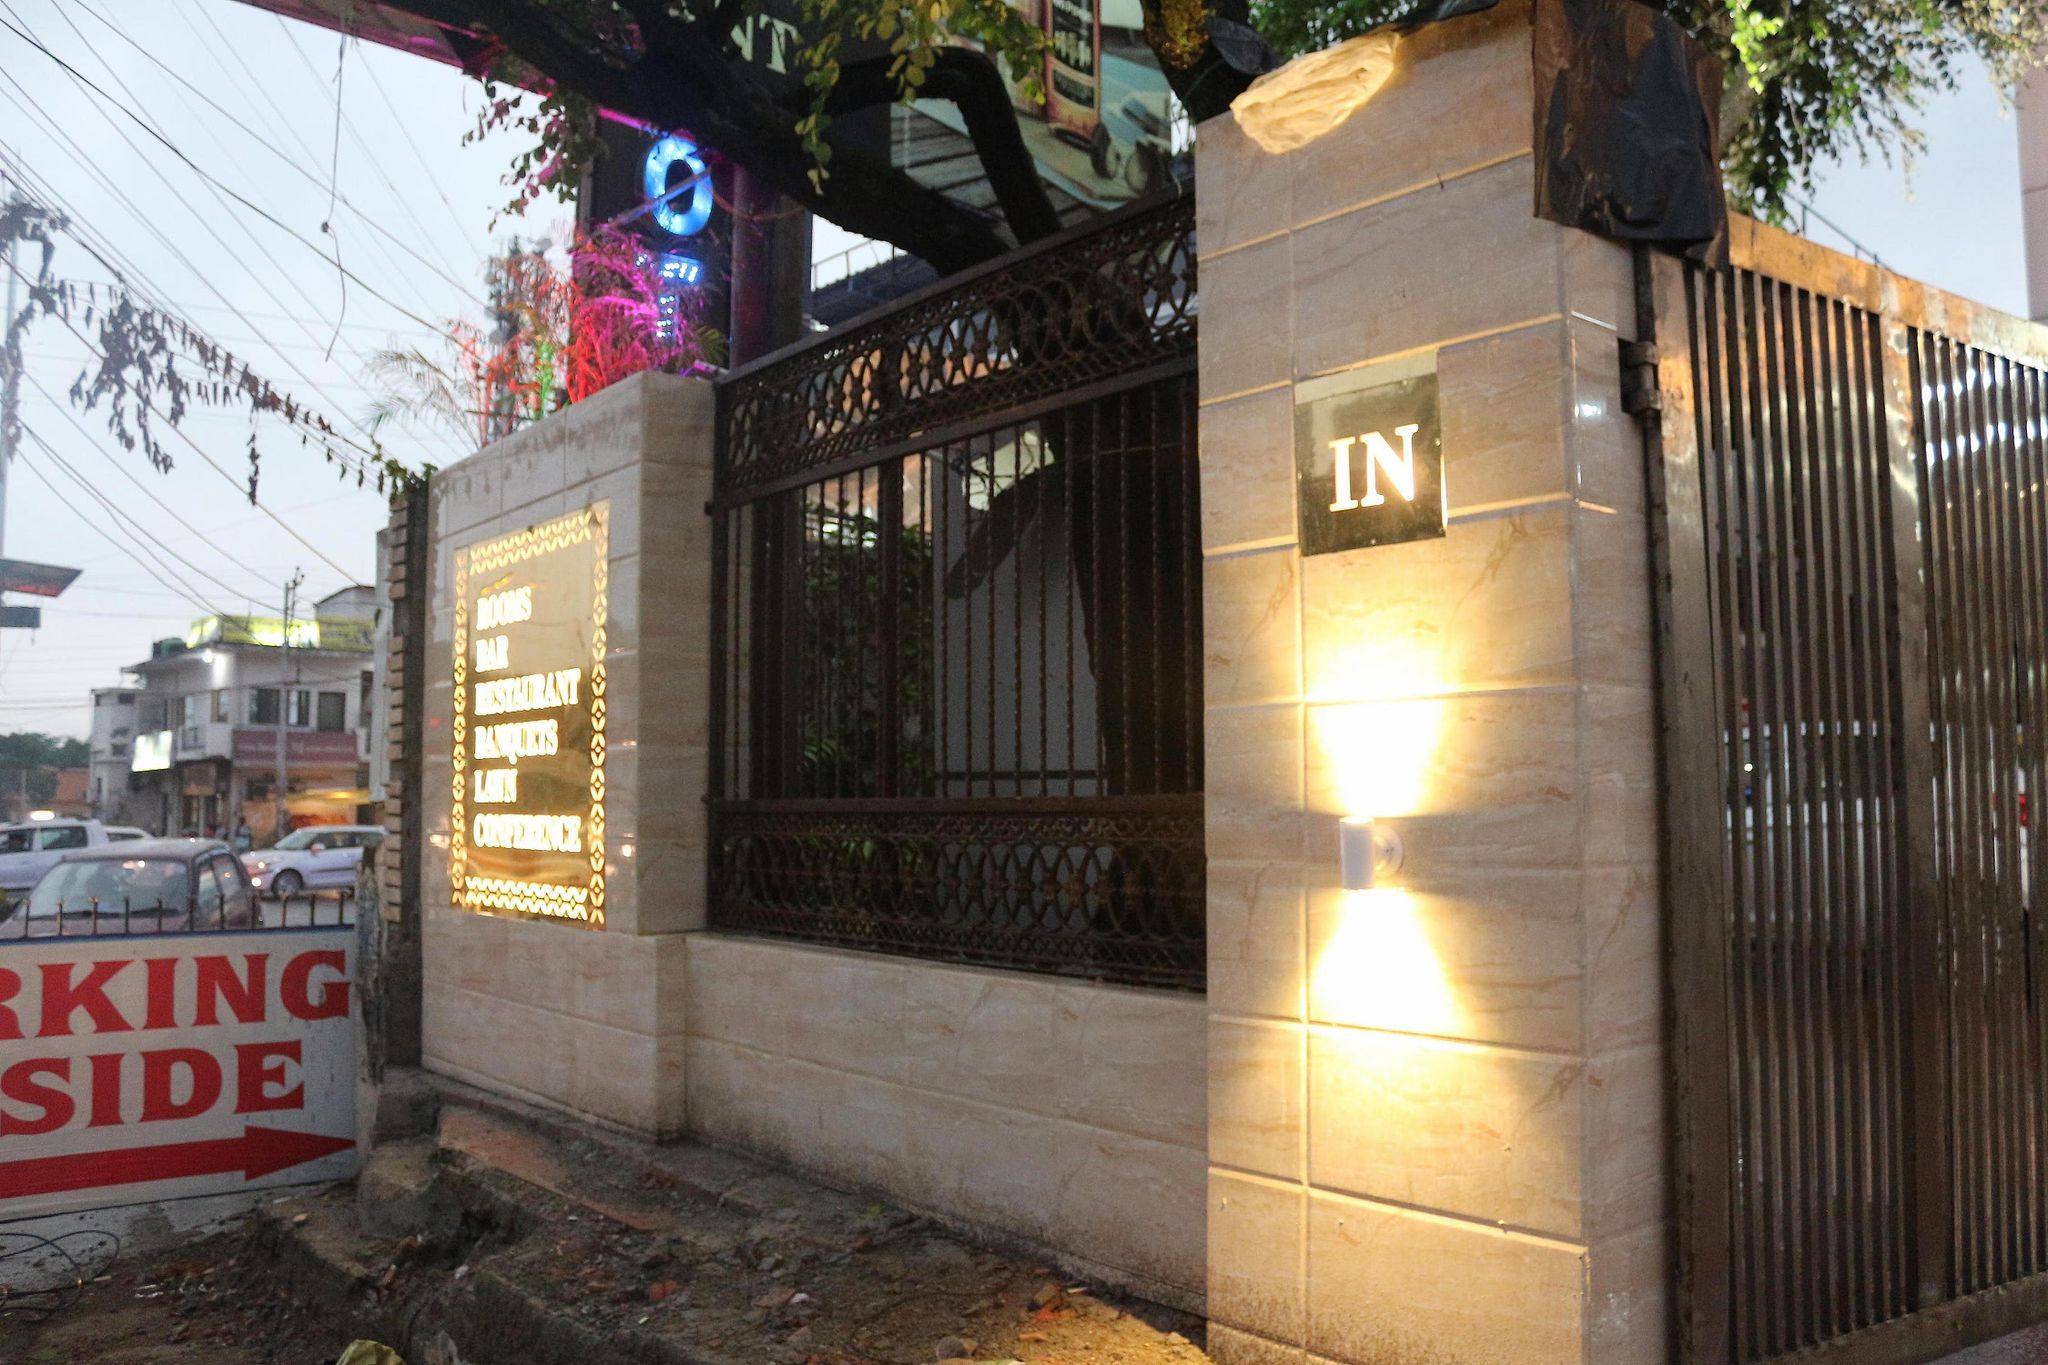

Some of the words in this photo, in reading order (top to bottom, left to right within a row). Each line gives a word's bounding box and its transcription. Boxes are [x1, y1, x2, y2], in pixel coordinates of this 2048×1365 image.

[1328, 423, 1419, 513] IN
[476, 586, 532, 631] ROOMS
[475, 635, 509, 673] BAR
[474, 668, 581, 716] RESTAURANT
[474, 719, 558, 765] BANQUETS
[474, 768, 518, 803] LAWN
[473, 813, 582, 853] CONFERENCE
[0, 1040, 304, 1137] SIDE
